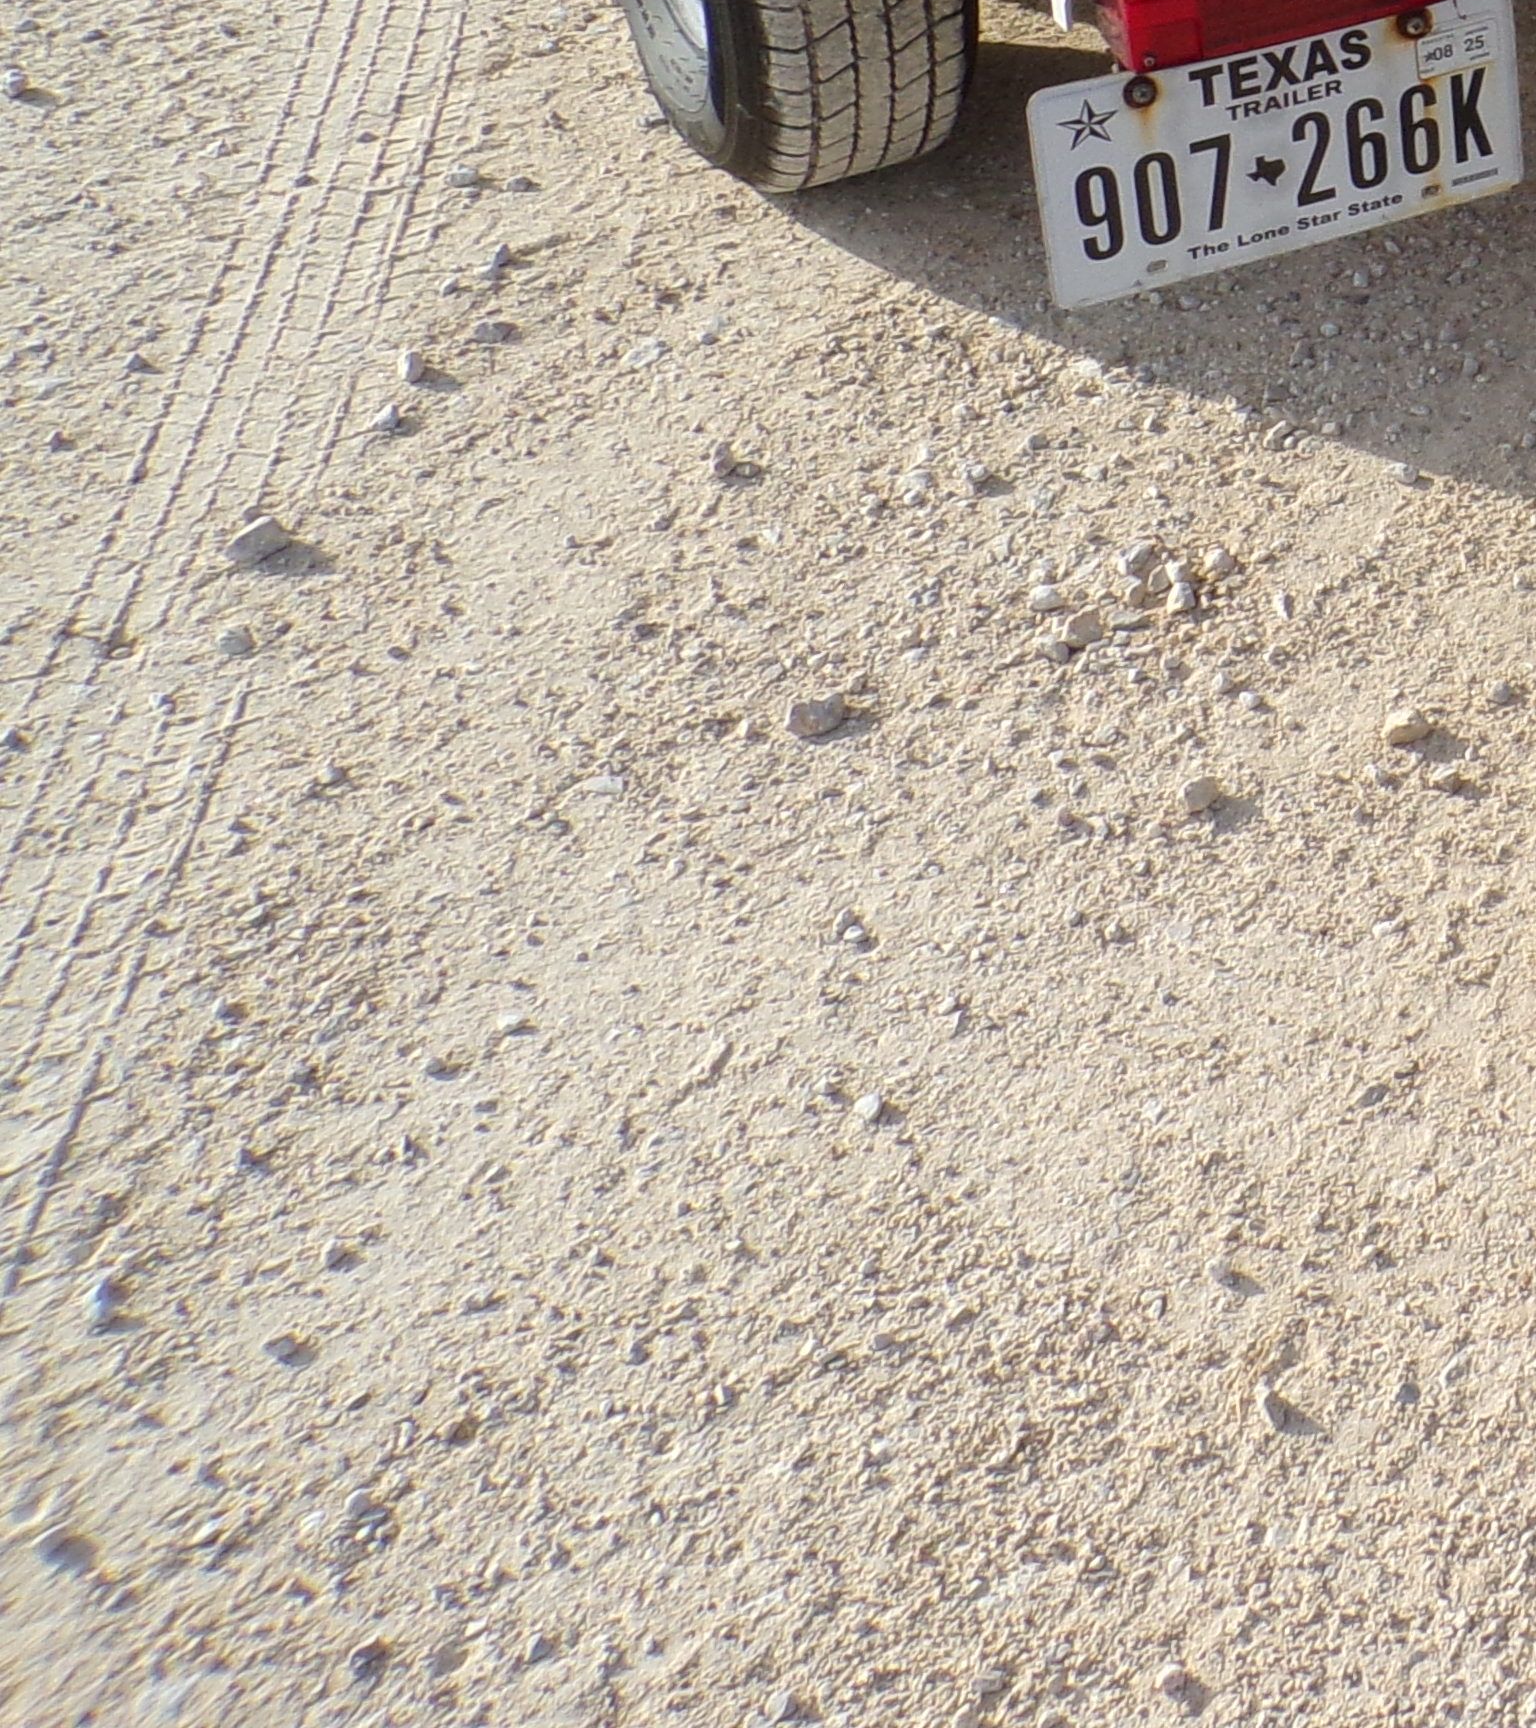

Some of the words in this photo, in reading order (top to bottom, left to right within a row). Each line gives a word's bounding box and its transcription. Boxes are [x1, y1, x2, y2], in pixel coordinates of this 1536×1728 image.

[1188, 29, 1372, 108] TEXAS
[1434, 44, 1454, 60] 08
[1464, 35, 1485, 52] 25
[1226, 80, 1342, 121] TRAILER
[1075, 133, 1232, 261] 907
[1291, 67, 1494, 208] 266K
[1187, 244, 1230, 260] The
[1237, 225, 1290, 247] Lone
[1296, 210, 1342, 231] Star
[1347, 192, 1403, 216] State
